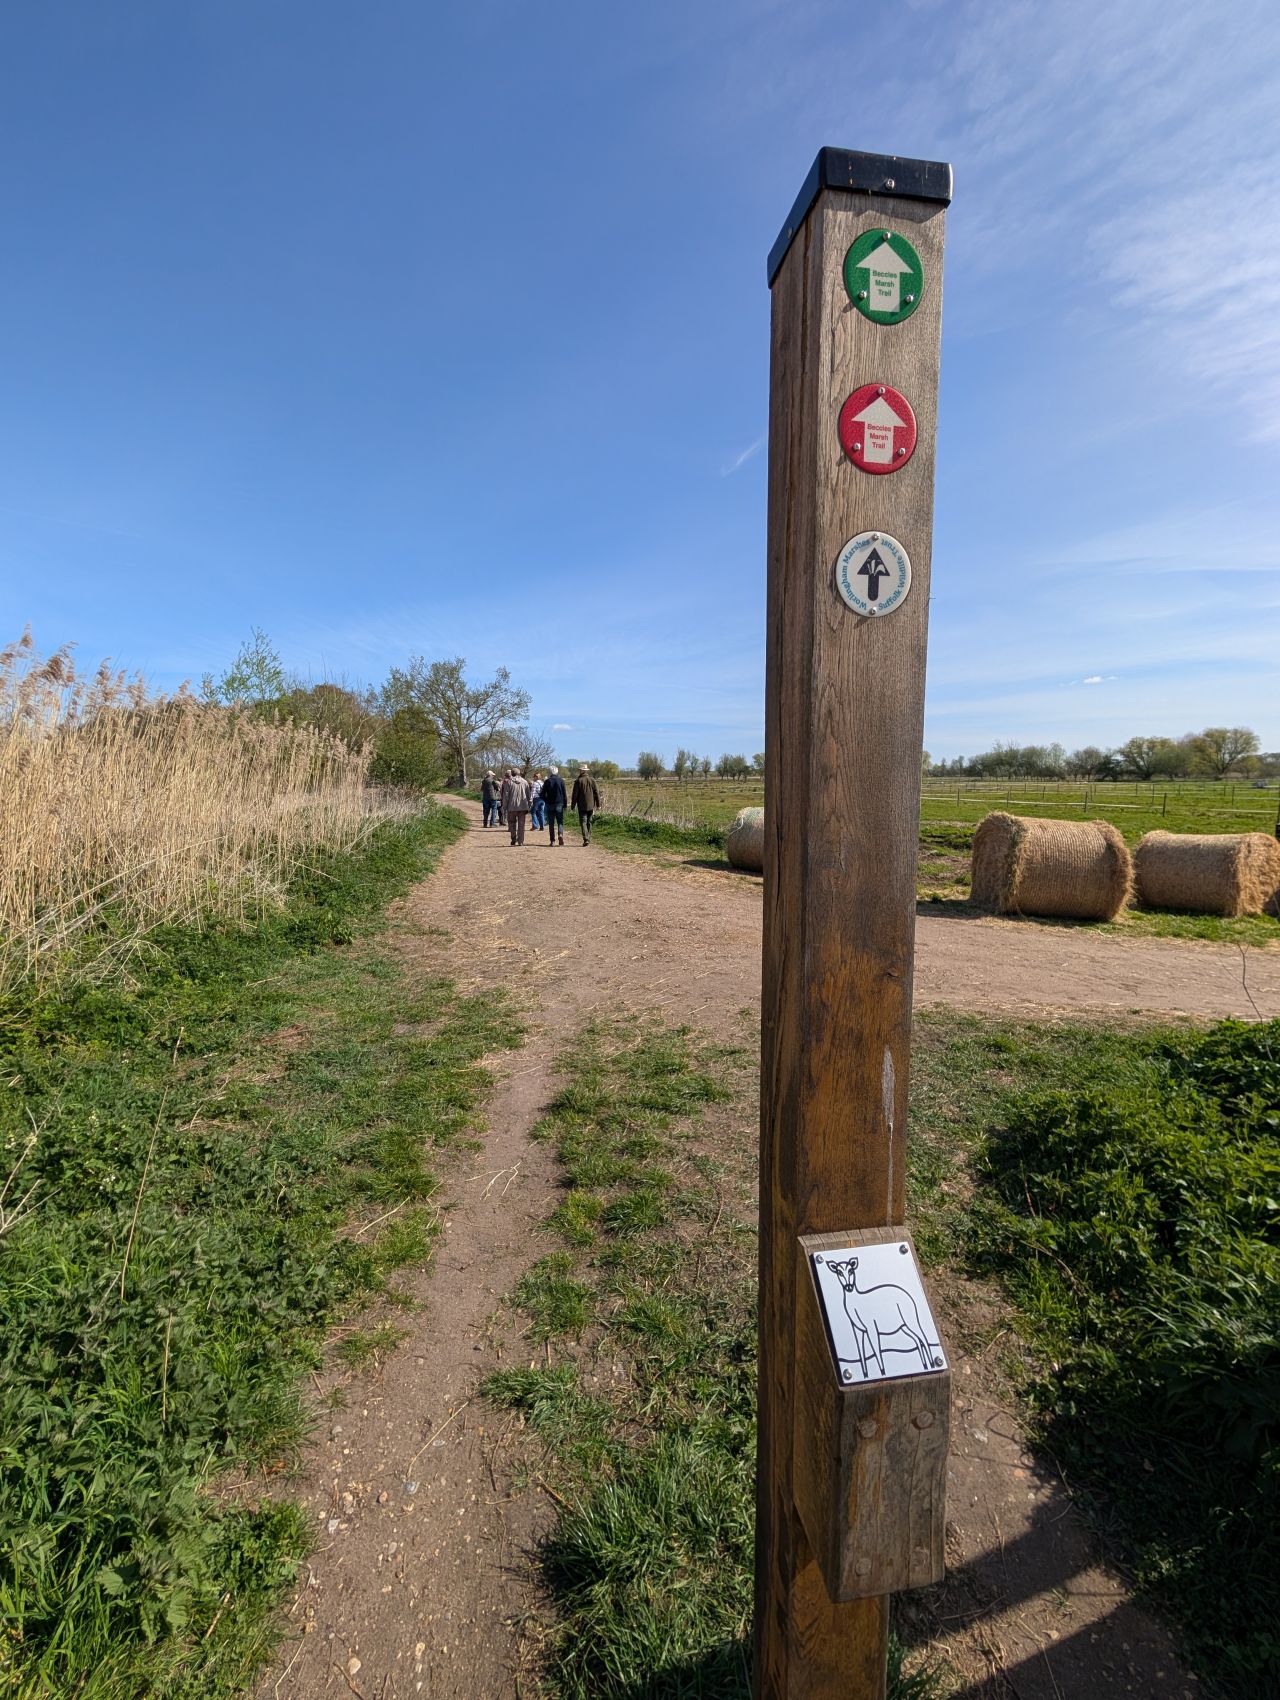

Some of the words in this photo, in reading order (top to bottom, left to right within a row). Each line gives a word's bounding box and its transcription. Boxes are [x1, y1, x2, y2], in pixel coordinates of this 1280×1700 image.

[872, 270, 897, 278] Beccles
[867, 424, 891, 432] Beccles
[843, 540, 870, 564] Marshes
[881, 539, 899, 557] Trust
[897, 555, 906, 588] Wildlife
[841, 565, 867, 610] Worlingham
[878, 589, 902, 610] Suffolk
